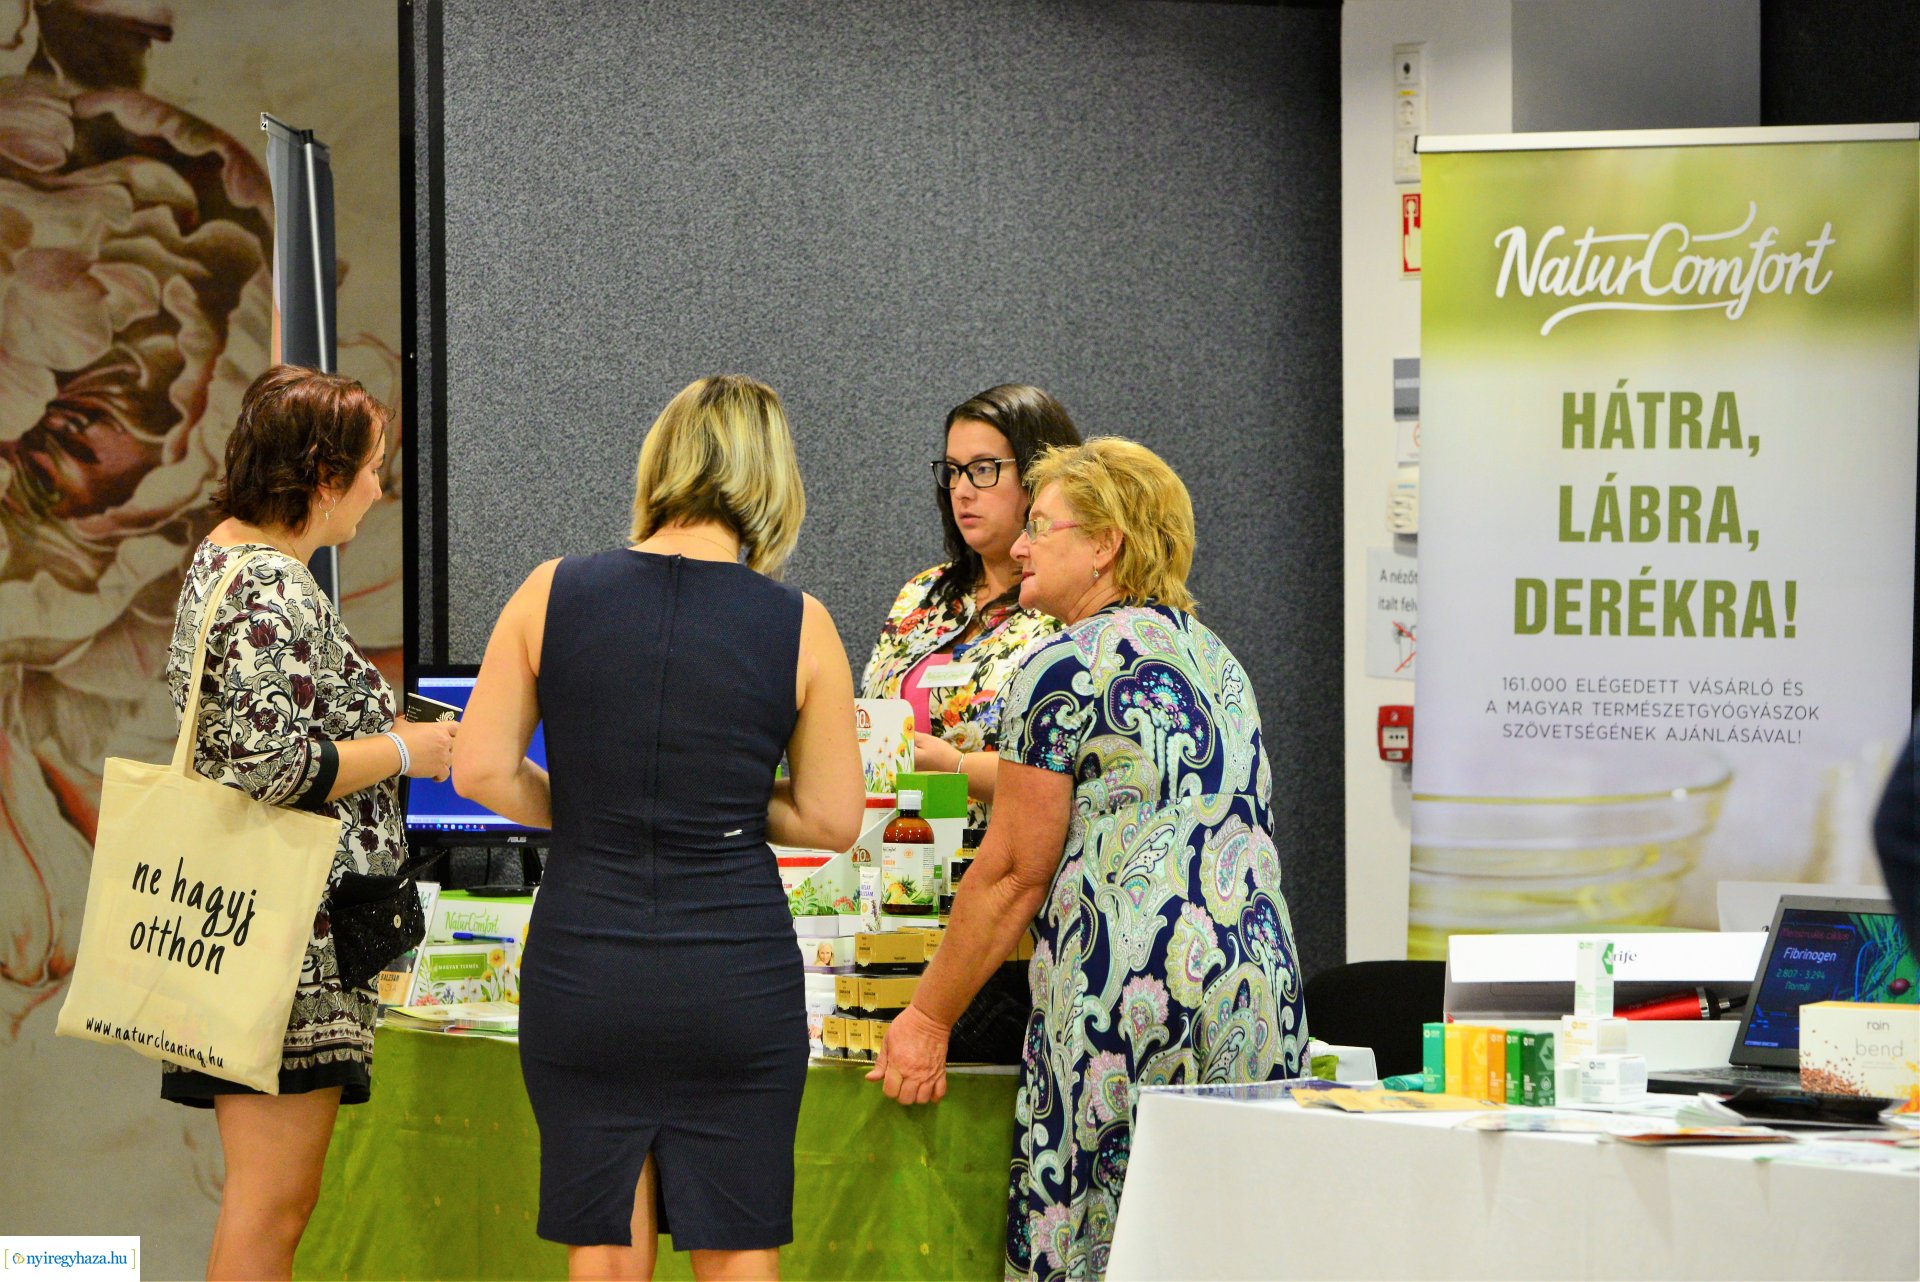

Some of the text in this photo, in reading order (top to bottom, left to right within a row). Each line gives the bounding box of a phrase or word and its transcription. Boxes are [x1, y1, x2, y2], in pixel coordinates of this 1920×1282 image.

[1495, 202, 1836, 336] NaturComfort
[1560, 378, 1761, 458] HÁTRA,
[1557, 472, 1760, 552] LÁBRA,
[1513, 566, 1797, 639] DERÉKRA!
[1501, 675, 1804, 697] 161.000 ELÉGEDETT VÁSÁRLÓ ÉS
[1485, 699, 1820, 721] A MAGYAR TERMÉSZETGYÓGYÁSZOK
[1502, 721, 1802, 745] SZÖVETSÉGÉNEK AJÁNLÁSÁVAL!
[131, 856, 257, 947] ne hagyj
[445, 907, 499, 935] NaturComfort
[129, 915, 225, 975] otthon
[1783, 947, 1837, 964] Fibrinogen
[85, 1016, 225, 1070] www.naturcleaning.hu
[1866, 1020, 1890, 1031] rain
[1855, 1037, 1904, 1057] bend
